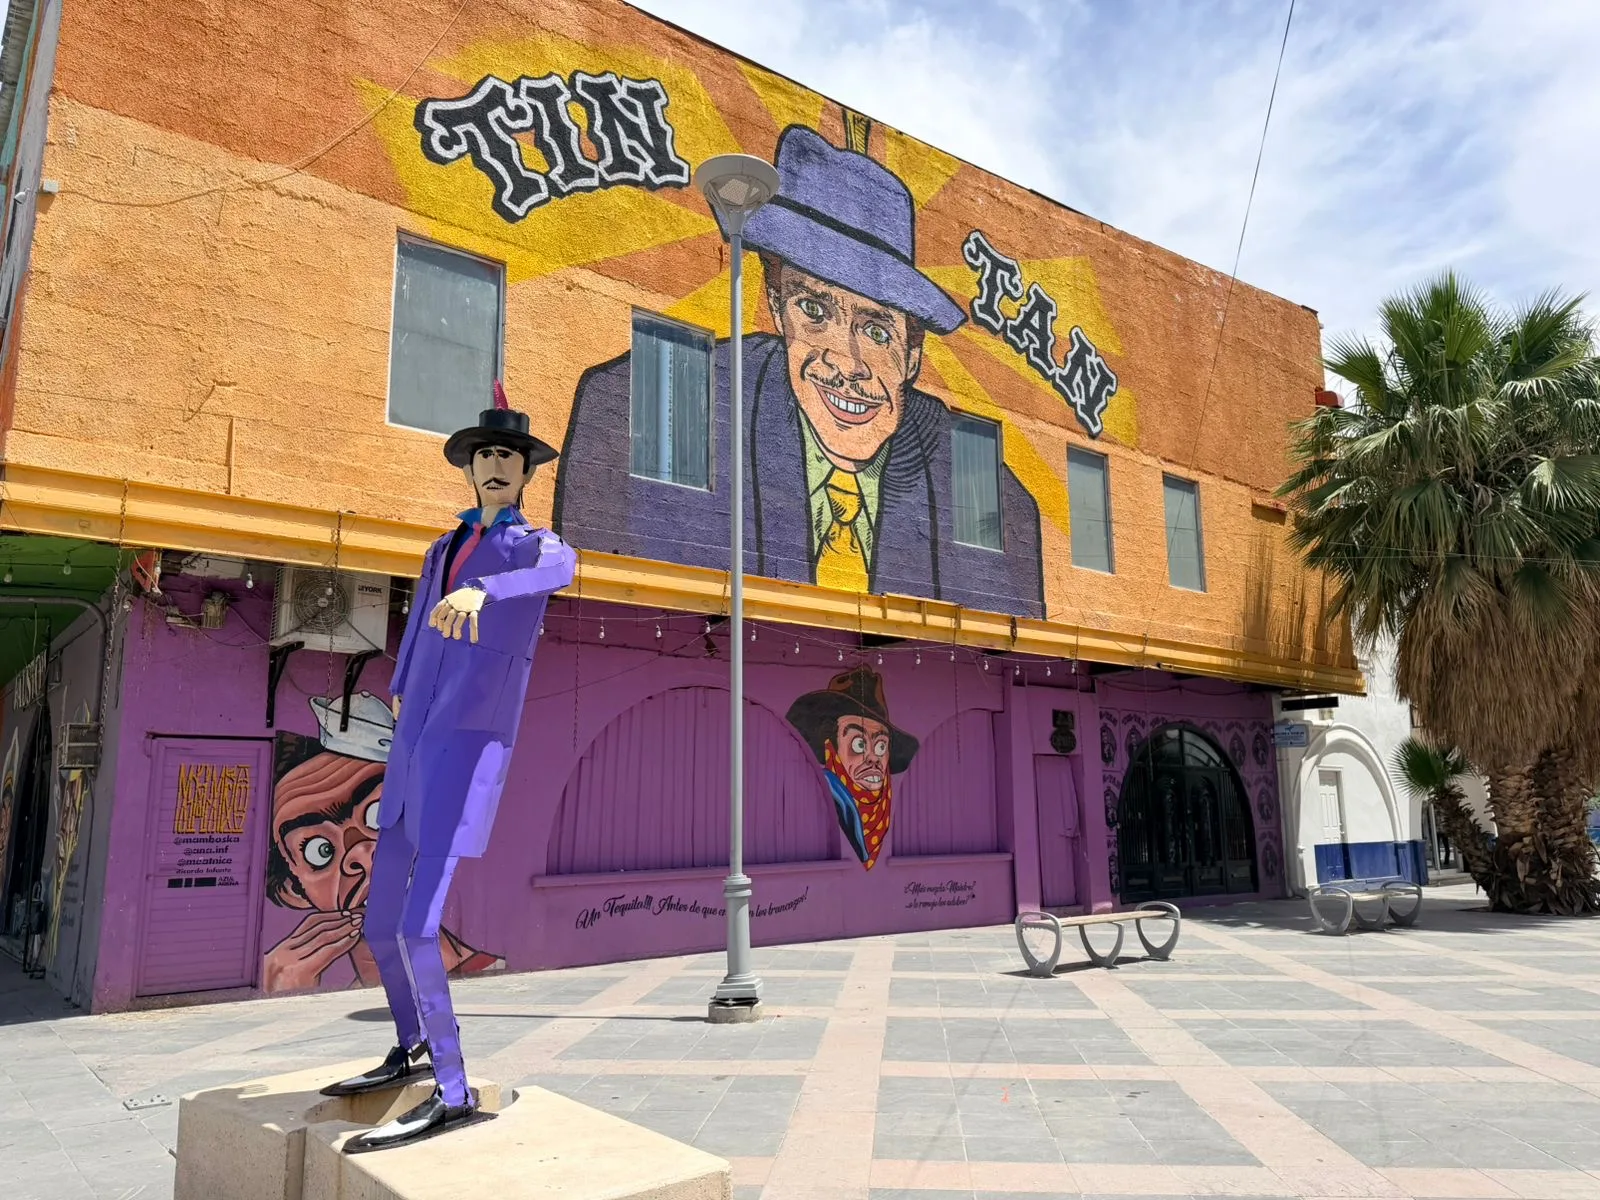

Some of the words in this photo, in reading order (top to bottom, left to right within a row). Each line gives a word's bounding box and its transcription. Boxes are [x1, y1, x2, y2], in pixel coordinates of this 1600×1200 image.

[413, 69, 691, 224] TIN
[961, 228, 1118, 440] TAN
[364, 585, 383, 593] YORK
[173, 835, 240, 845] @mamboska
[575, 908, 601, 929] Un
[652, 895, 688, 916] Antes
[689, 900, 701, 914] de
[702, 905, 717, 919] que
